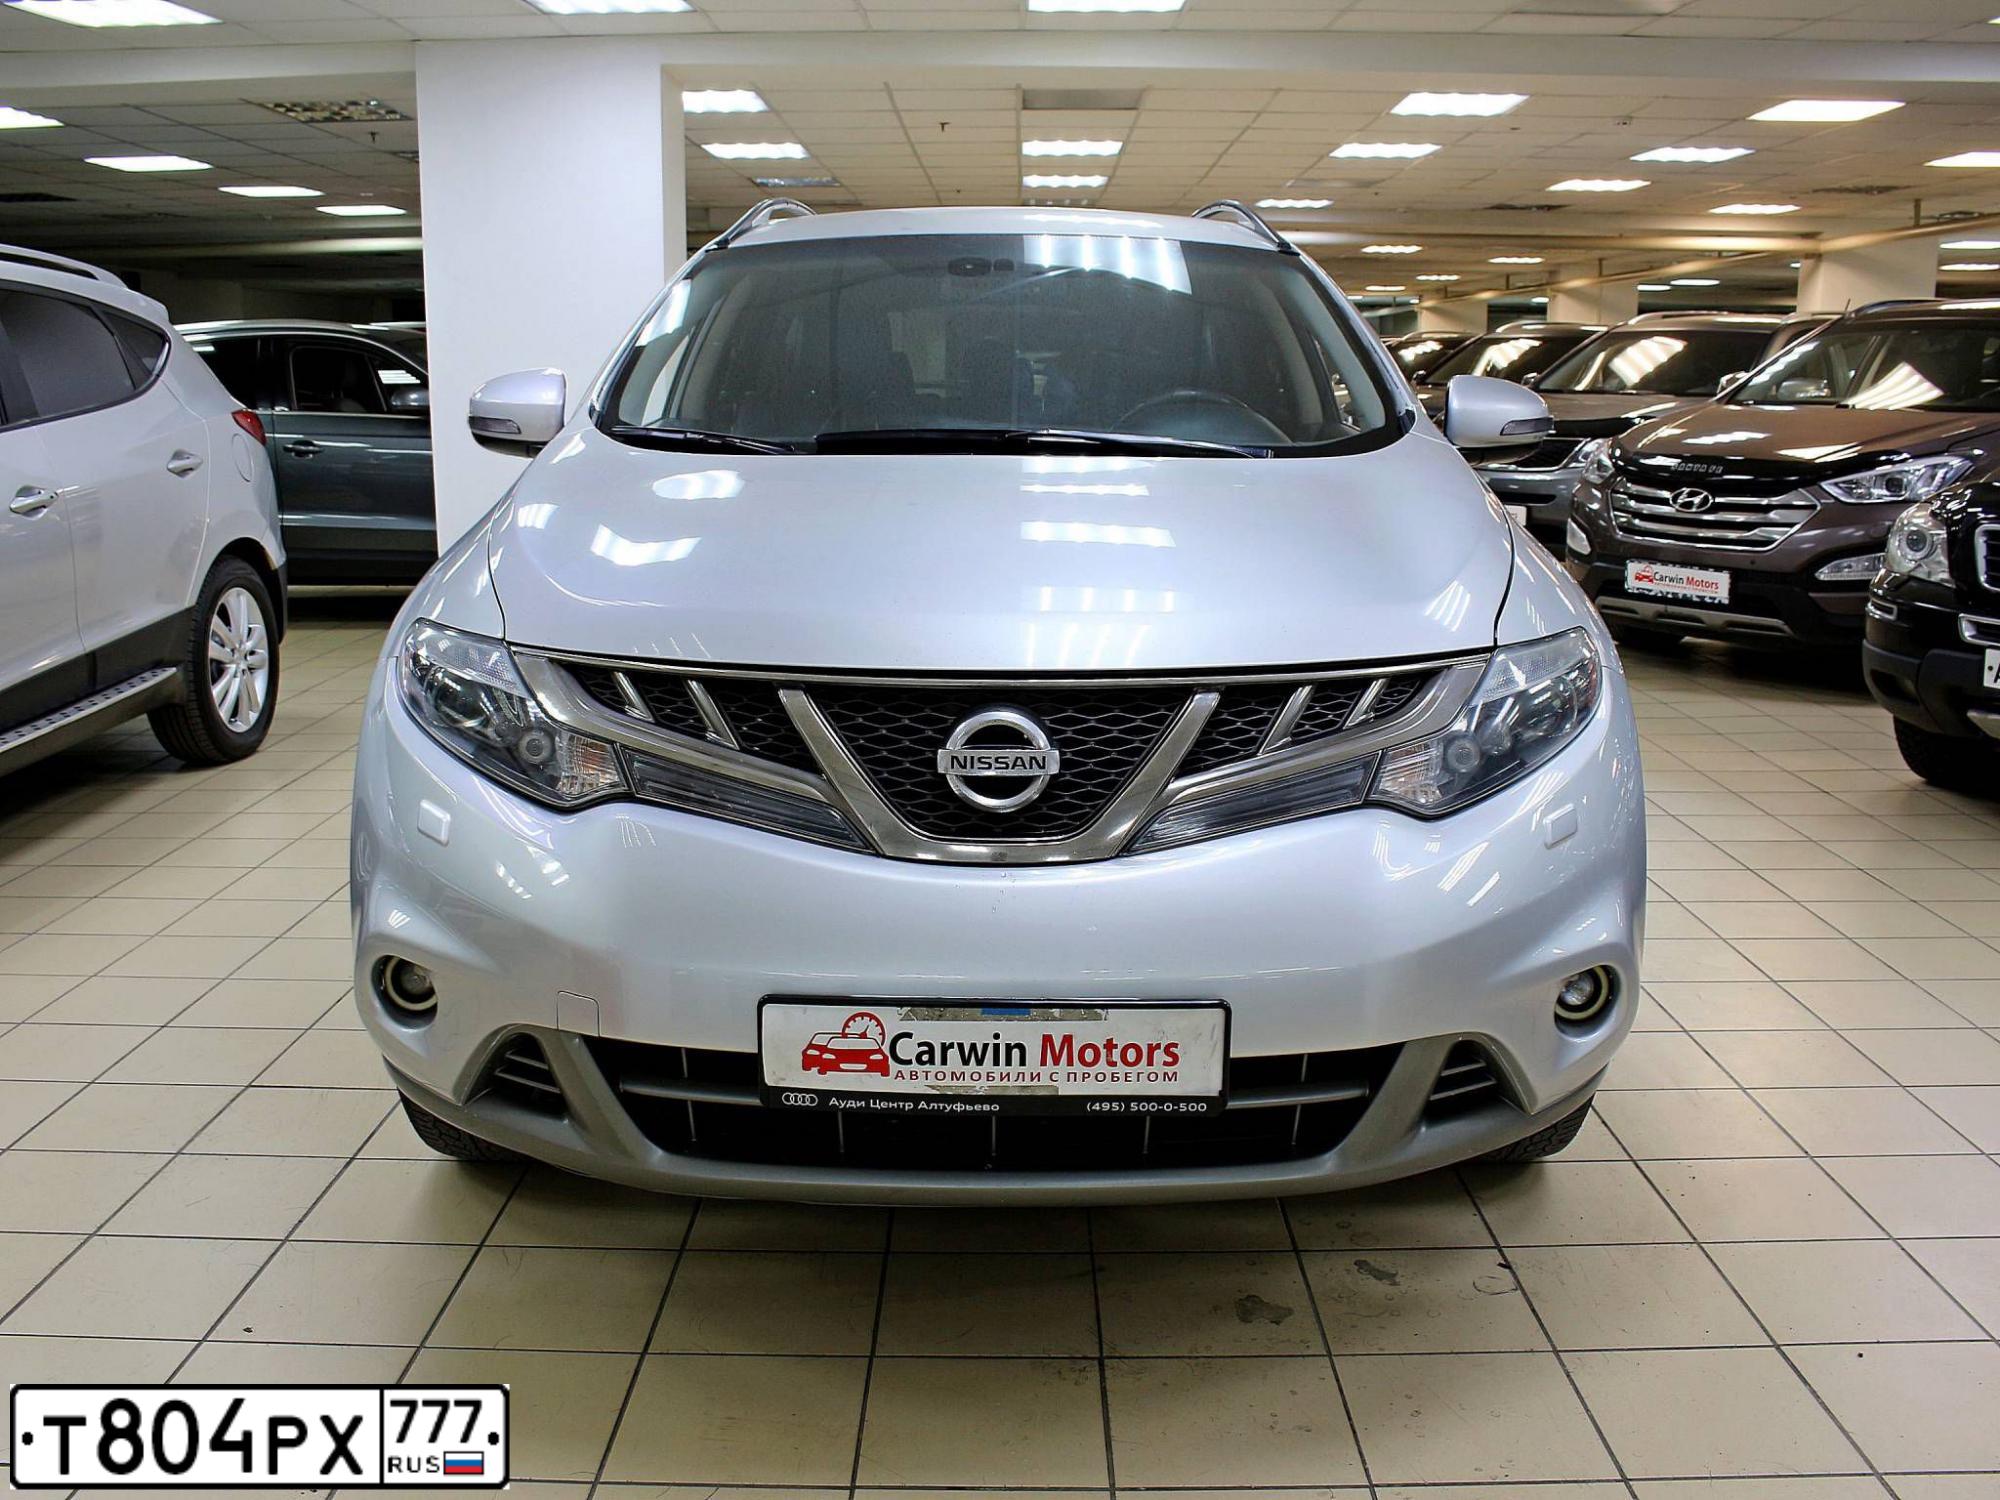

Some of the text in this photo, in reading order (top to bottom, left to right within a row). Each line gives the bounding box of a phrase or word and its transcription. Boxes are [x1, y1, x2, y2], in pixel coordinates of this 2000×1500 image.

[1654, 571, 1684, 585] Carwin
[1685, 576, 1719, 590] Motors
[950, 755, 1046, 770] NISSAN
[889, 1031, 1180, 1068] Carwin Motors
[894, 1070, 1042, 1083] АВТОМОБИЛИ
[1066, 1070, 1179, 1083] ПРОБЕГОМ
[829, 1097, 1000, 1113] Ауди Центр Алтуфьево
[1086, 1102, 1207, 1112] (495) 500-0-500
